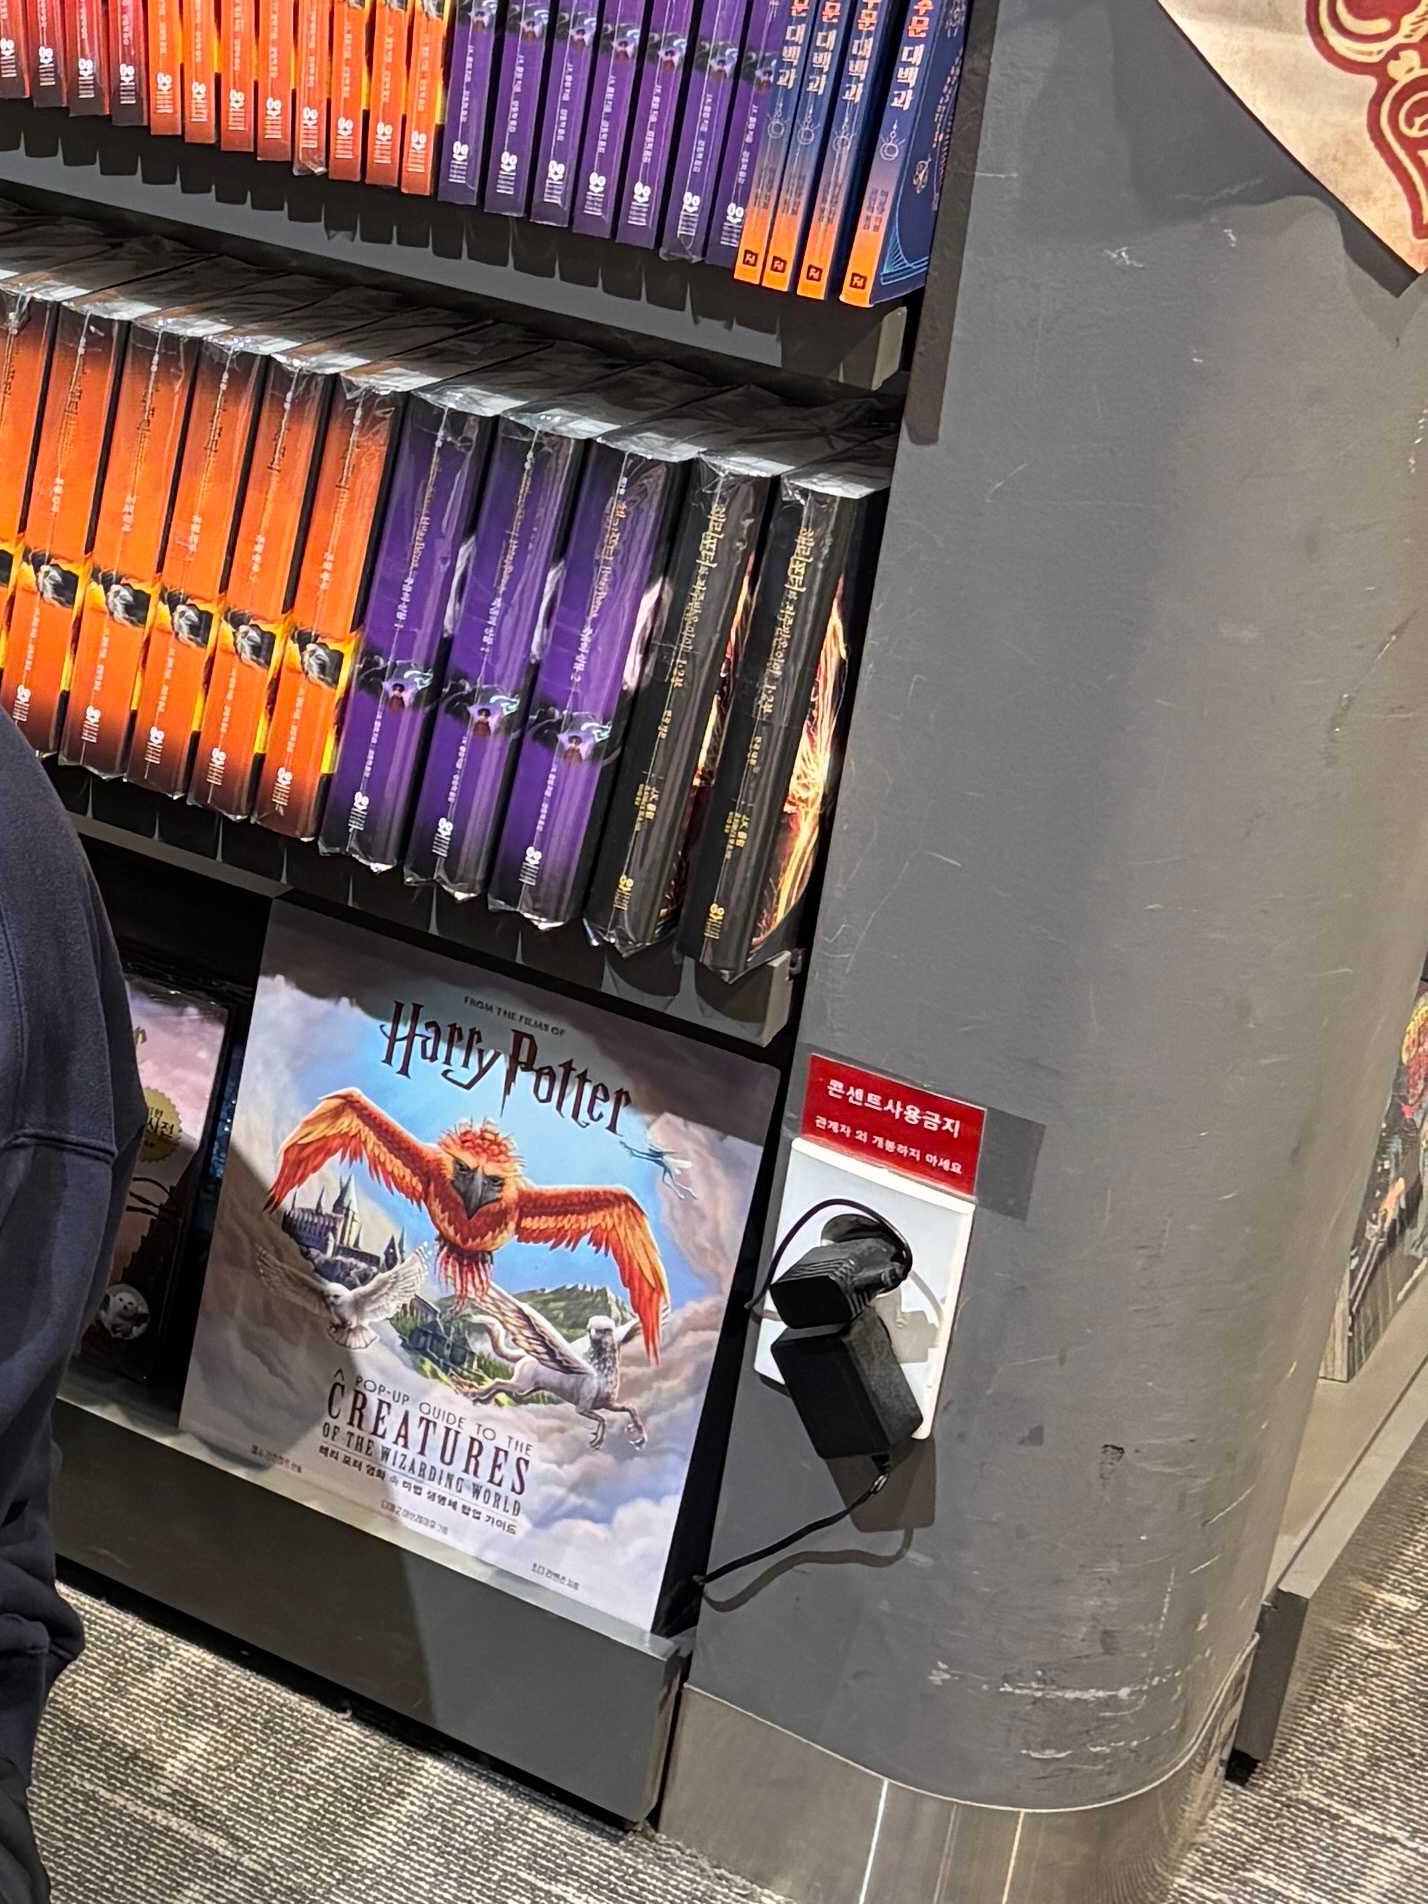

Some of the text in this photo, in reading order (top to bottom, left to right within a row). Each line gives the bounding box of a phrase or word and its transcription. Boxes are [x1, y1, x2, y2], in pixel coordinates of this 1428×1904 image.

[776, 24, 805, 89] 대백과
[805, 30, 836, 96] 대백과
[842, 38, 874, 104] 대백과
[891, 44, 925, 111] 대백과
[464, 996, 566, 1038] FROM THE FILMS OF
[379, 1000, 633, 1137] Harry Potter
[826, 1078, 961, 1138] 콘센트사용금지
[815, 1114, 852, 1139] 관계자
[855, 1128, 868, 1143] 외
[925, 1152, 963, 1176] 마세요
[327, 1382, 530, 1496] CREATURES
[333, 1368, 534, 1456] A POP-UP GUIDE TO THE
[319, 1445, 340, 1462] 해리
[343, 1455, 364, 1473] 포터
[366, 1463, 386, 1481] 영화
[402, 1480, 423, 1498] 마법
[426, 1488, 459, 1512] 생명체
[461, 1503, 482, 1522] 팝업
[484, 1513, 518, 1536] 가이드
[322, 1421, 340, 1441] OF
[346, 1431, 374, 1456] THE
[380, 1446, 464, 1493] WIZARDING
[472, 1482, 522, 1518] WORLD
